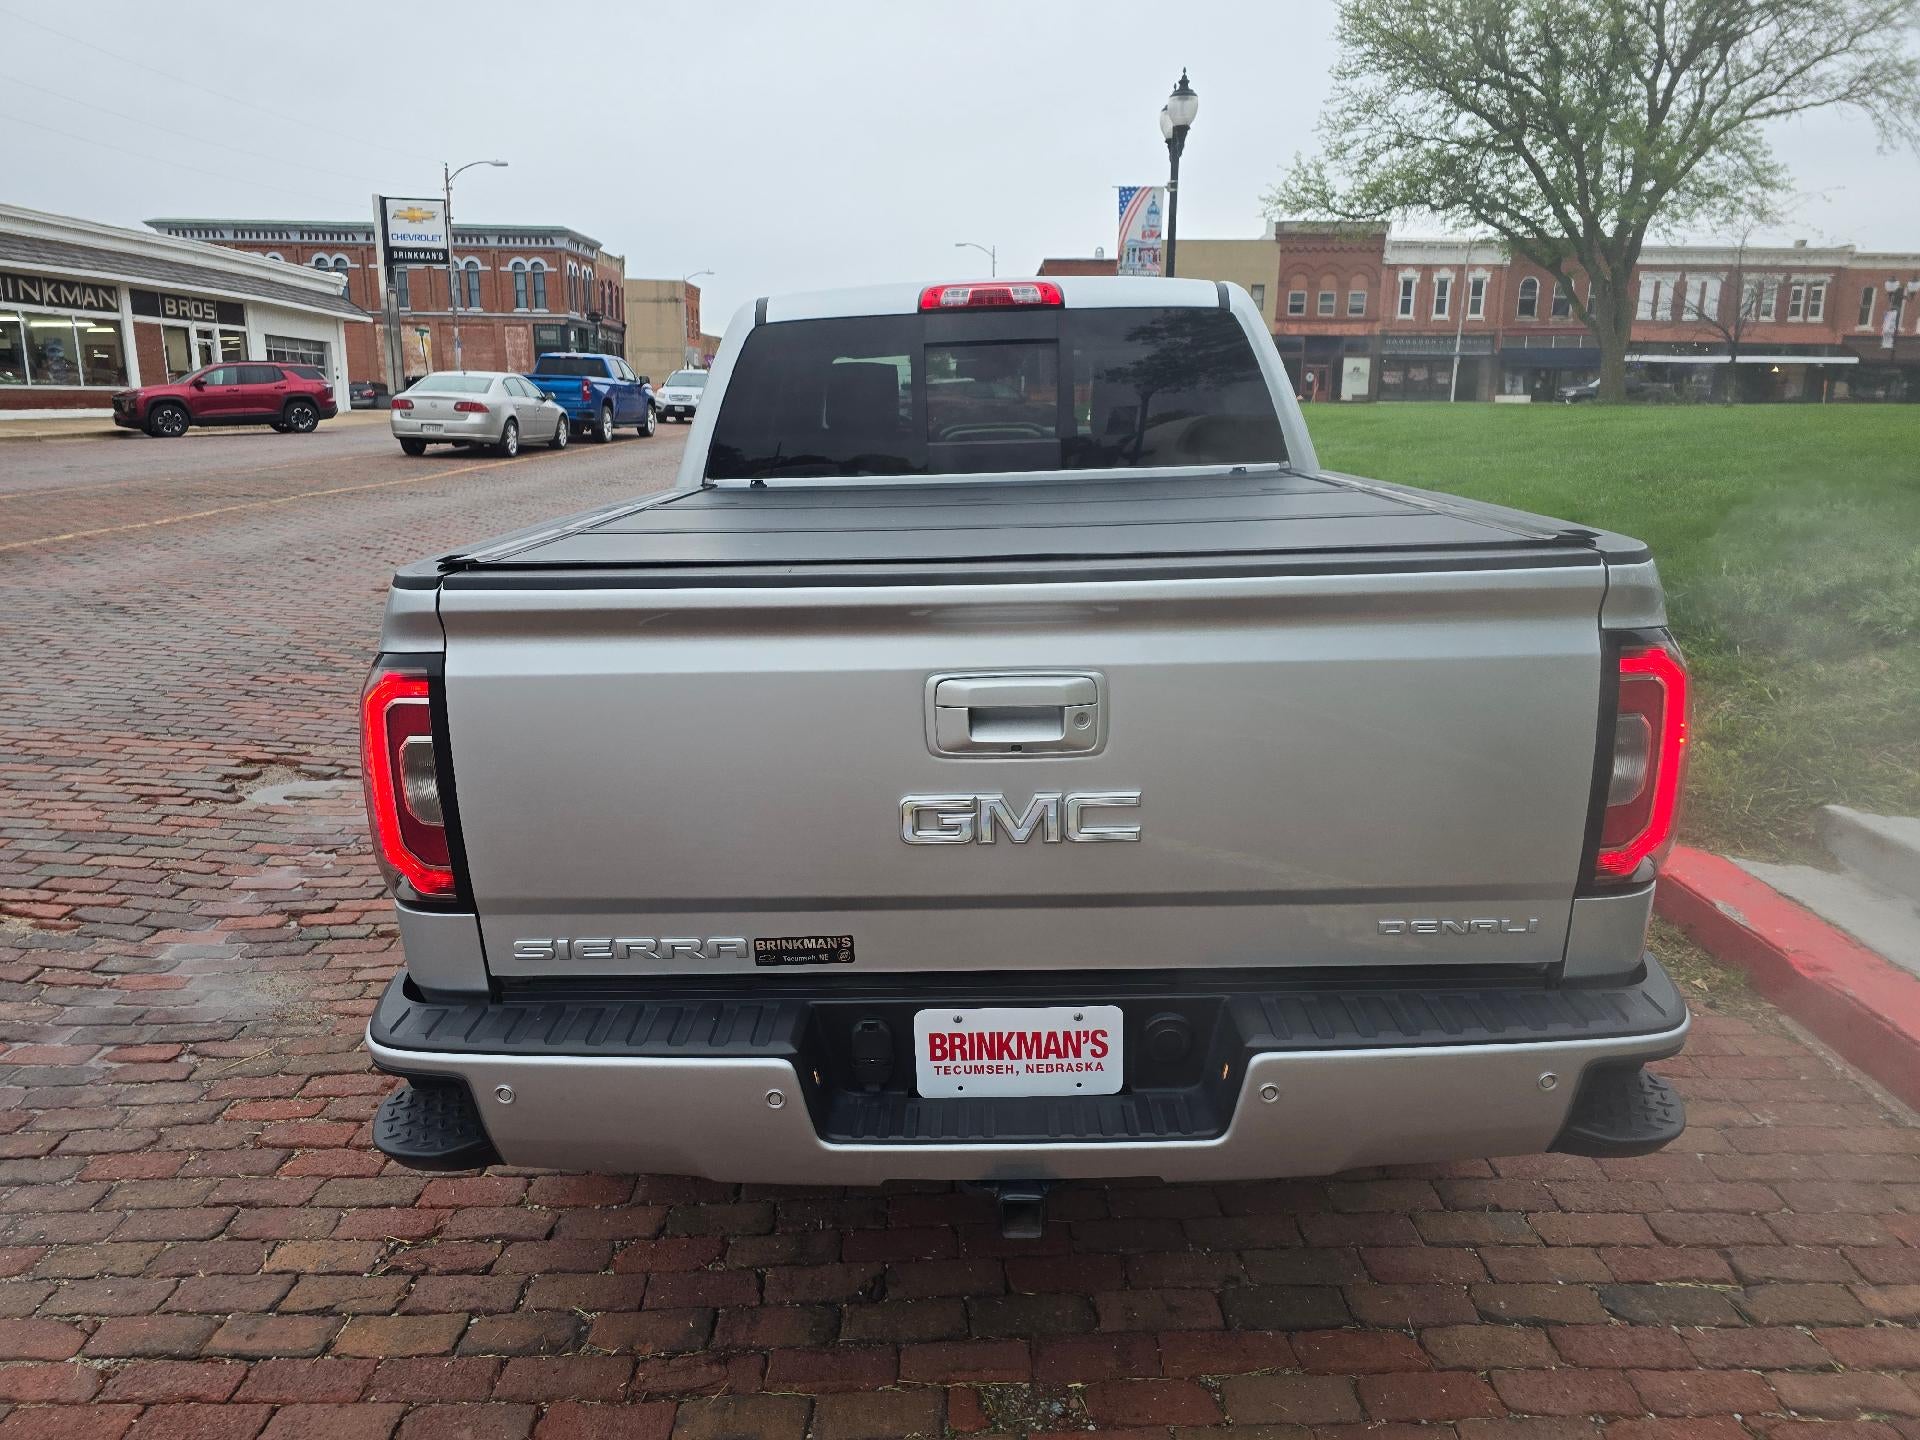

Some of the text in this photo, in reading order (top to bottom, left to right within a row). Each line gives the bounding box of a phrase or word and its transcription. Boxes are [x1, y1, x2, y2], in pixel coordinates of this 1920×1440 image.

[391, 233, 442, 242] CHEVROLET
[393, 251, 443, 260] BRINKMAN'S
[0, 276, 215, 319] INKMAN BROS
[900, 791, 1141, 845] GMC
[1377, 918, 1539, 936] DENALI
[513, 936, 750, 961] SIERRA
[755, 937, 851, 950] BRINKMAN'S
[819, 953, 829, 961] NE
[928, 1029, 1109, 1062] BRINKMAN'S
[934, 1062, 1105, 1076] TECUMSEH, NEBRASKA
